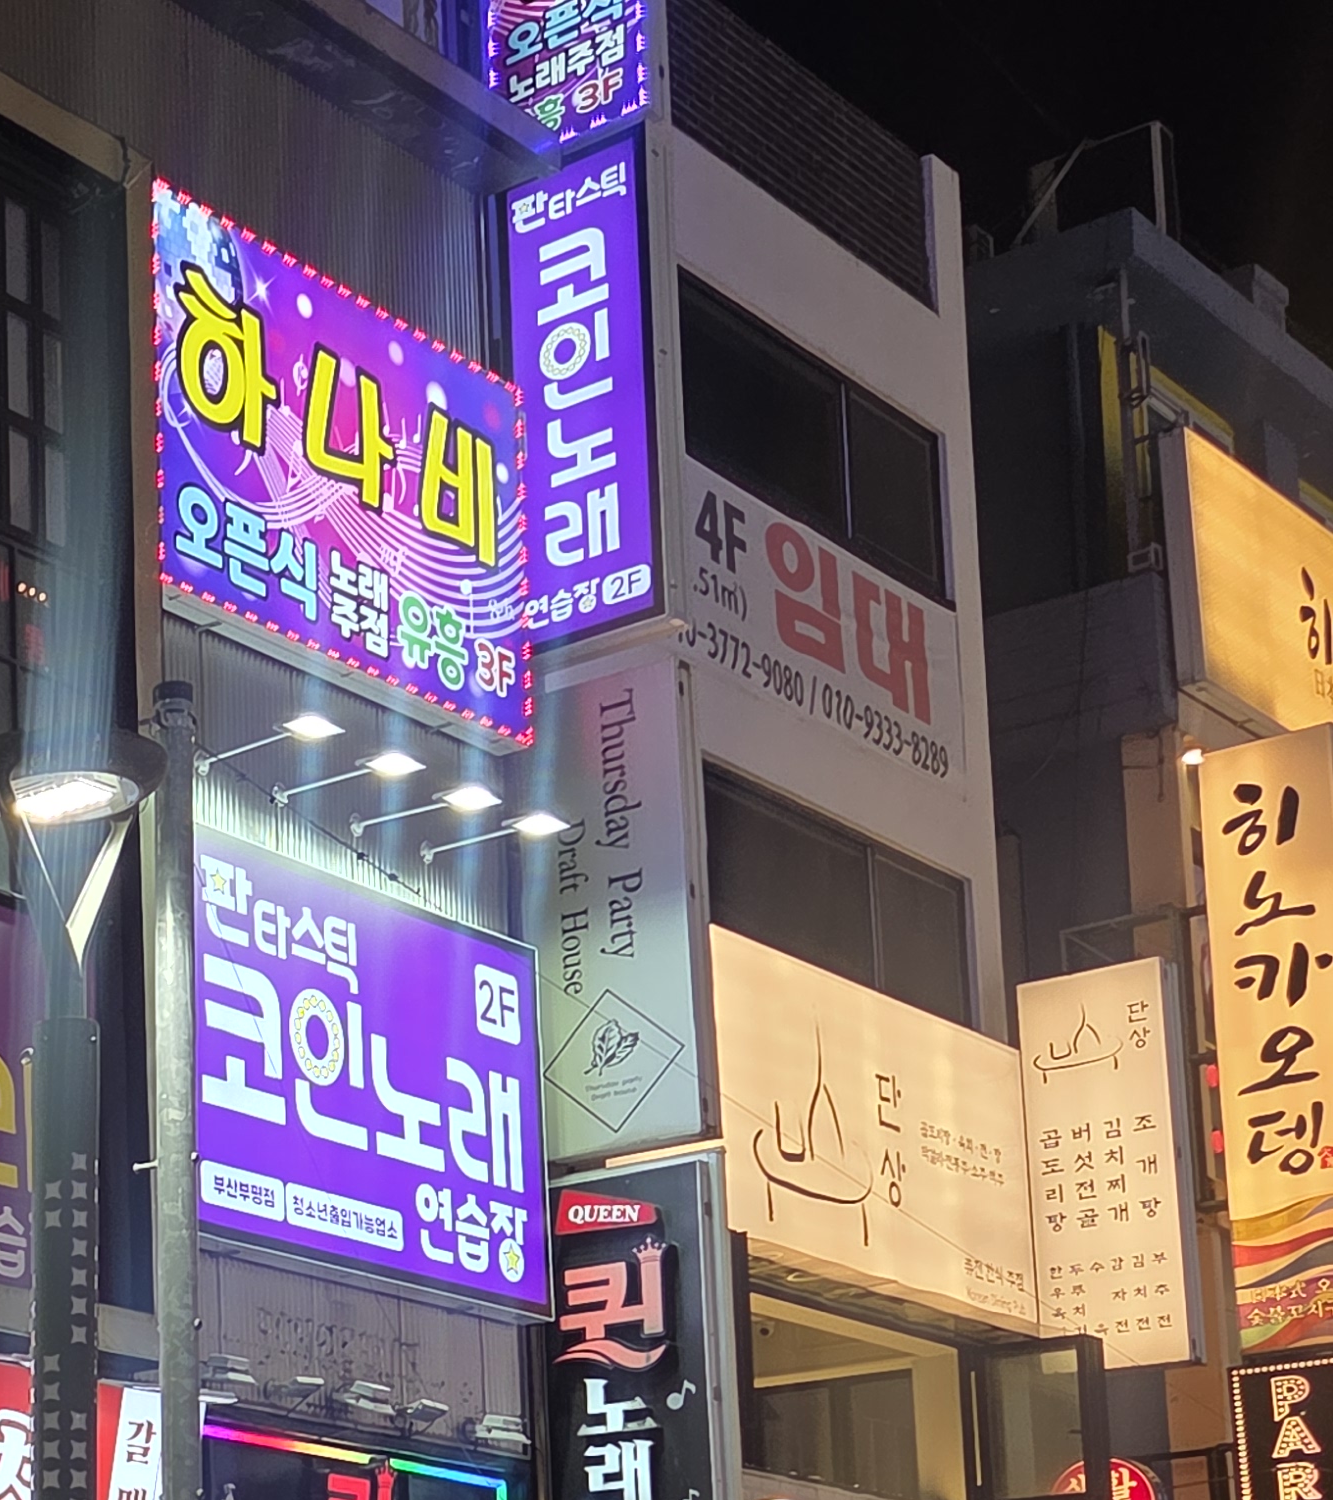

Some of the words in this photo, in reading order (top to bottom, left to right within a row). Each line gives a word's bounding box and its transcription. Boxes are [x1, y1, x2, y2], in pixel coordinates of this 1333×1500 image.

[509, 22, 626, 104] 노래주점
[525, 93, 566, 131] 흥
[572, 67, 624, 113] 3F
[511, 162, 627, 233] 판타스틱
[177, 262, 499, 570] 하나비
[536, 226, 624, 568] 코인노래
[174, 482, 319, 622] 오픈식
[329, 549, 389, 606] 노래
[694, 490, 746, 574] 4F
[330, 600, 390, 660] 주점
[524, 577, 600, 630] 연습장
[610, 569, 642, 600] 2F
[764, 522, 931, 726] 임대
[396, 593, 471, 692] 유흥
[473, 643, 516, 698] 3F
[595, 688, 642, 852] Thursday
[822, 683, 950, 779] 010-9333-8289
[555, 818, 589, 896] Draft
[200, 854, 359, 995] 판타스틱
[559, 908, 589, 996] House
[600, 867, 644, 960] Party
[479, 979, 517, 1030] 2F
[1126, 1000, 1151, 1049] 단상
[1222, 783, 1333, 1175] 히노카오뎅
[202, 953, 525, 1195] 코인노래
[874, 1073, 906, 1208] 단상
[1039, 1129, 1067, 1232] 곱도리탕
[1071, 1122, 1099, 1229] 버섯전골
[1103, 1117, 1129, 1222] 김치찌개
[1132, 1114, 1163, 1218] 조개탕
[416, 1182, 529, 1284] 연습장
[568, 1204, 641, 1223] QUEEN
[559, 1236, 668, 1339] 퀸
